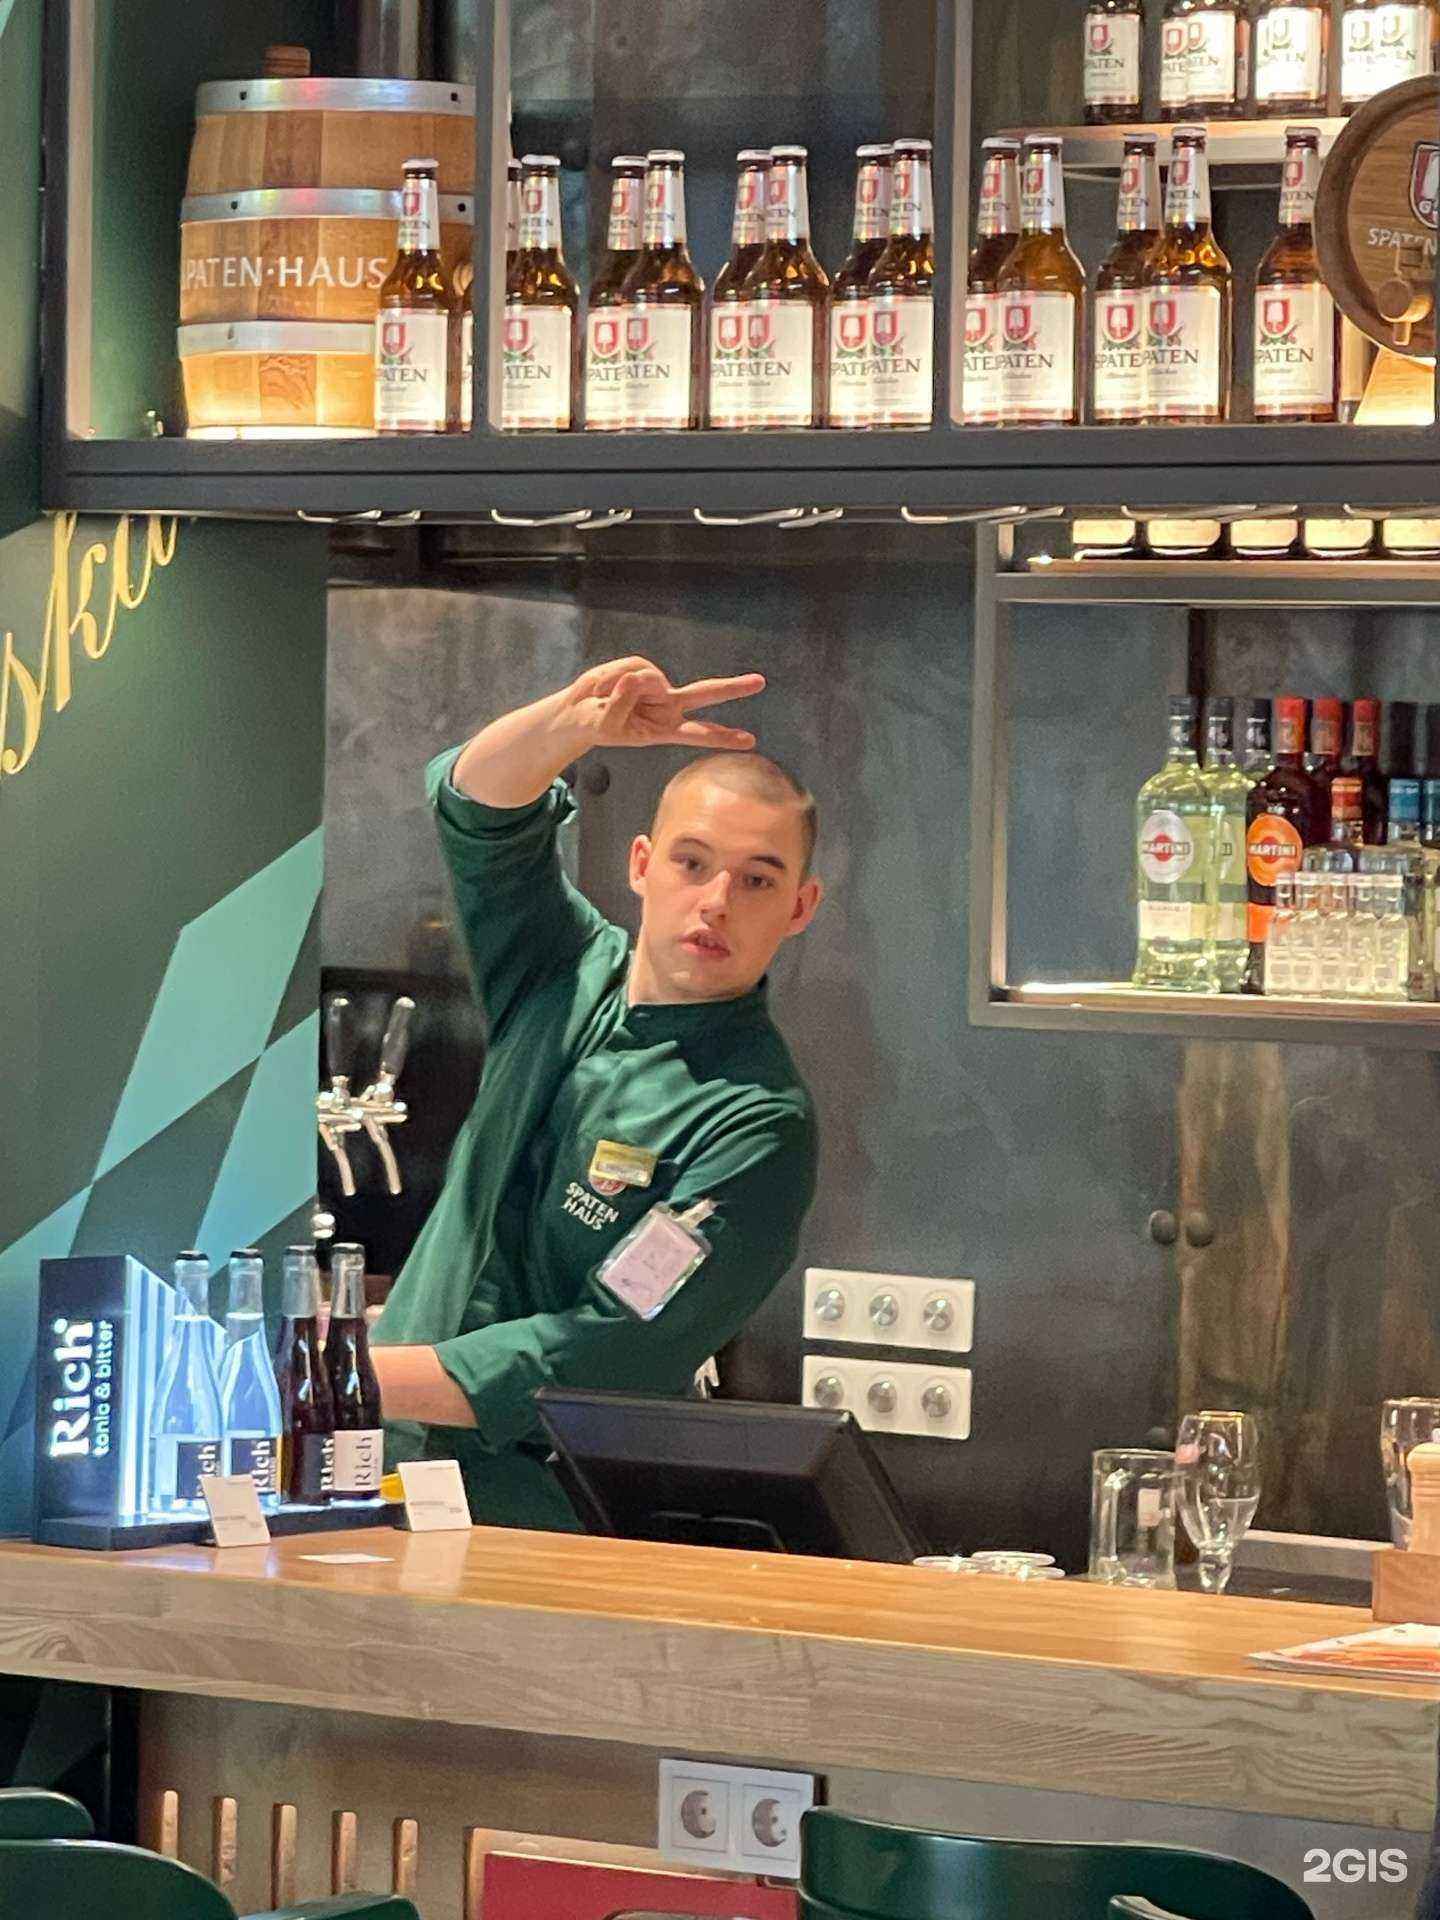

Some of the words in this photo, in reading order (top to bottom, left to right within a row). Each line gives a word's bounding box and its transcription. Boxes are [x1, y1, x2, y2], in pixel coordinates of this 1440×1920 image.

[560, 1197, 605, 1230] HAUS
[565, 1182, 619, 1222] SPATEN
[94, 1319, 114, 1379] bitter
[49, 1318, 93, 1457] Rich
[94, 1382, 111, 1400] &
